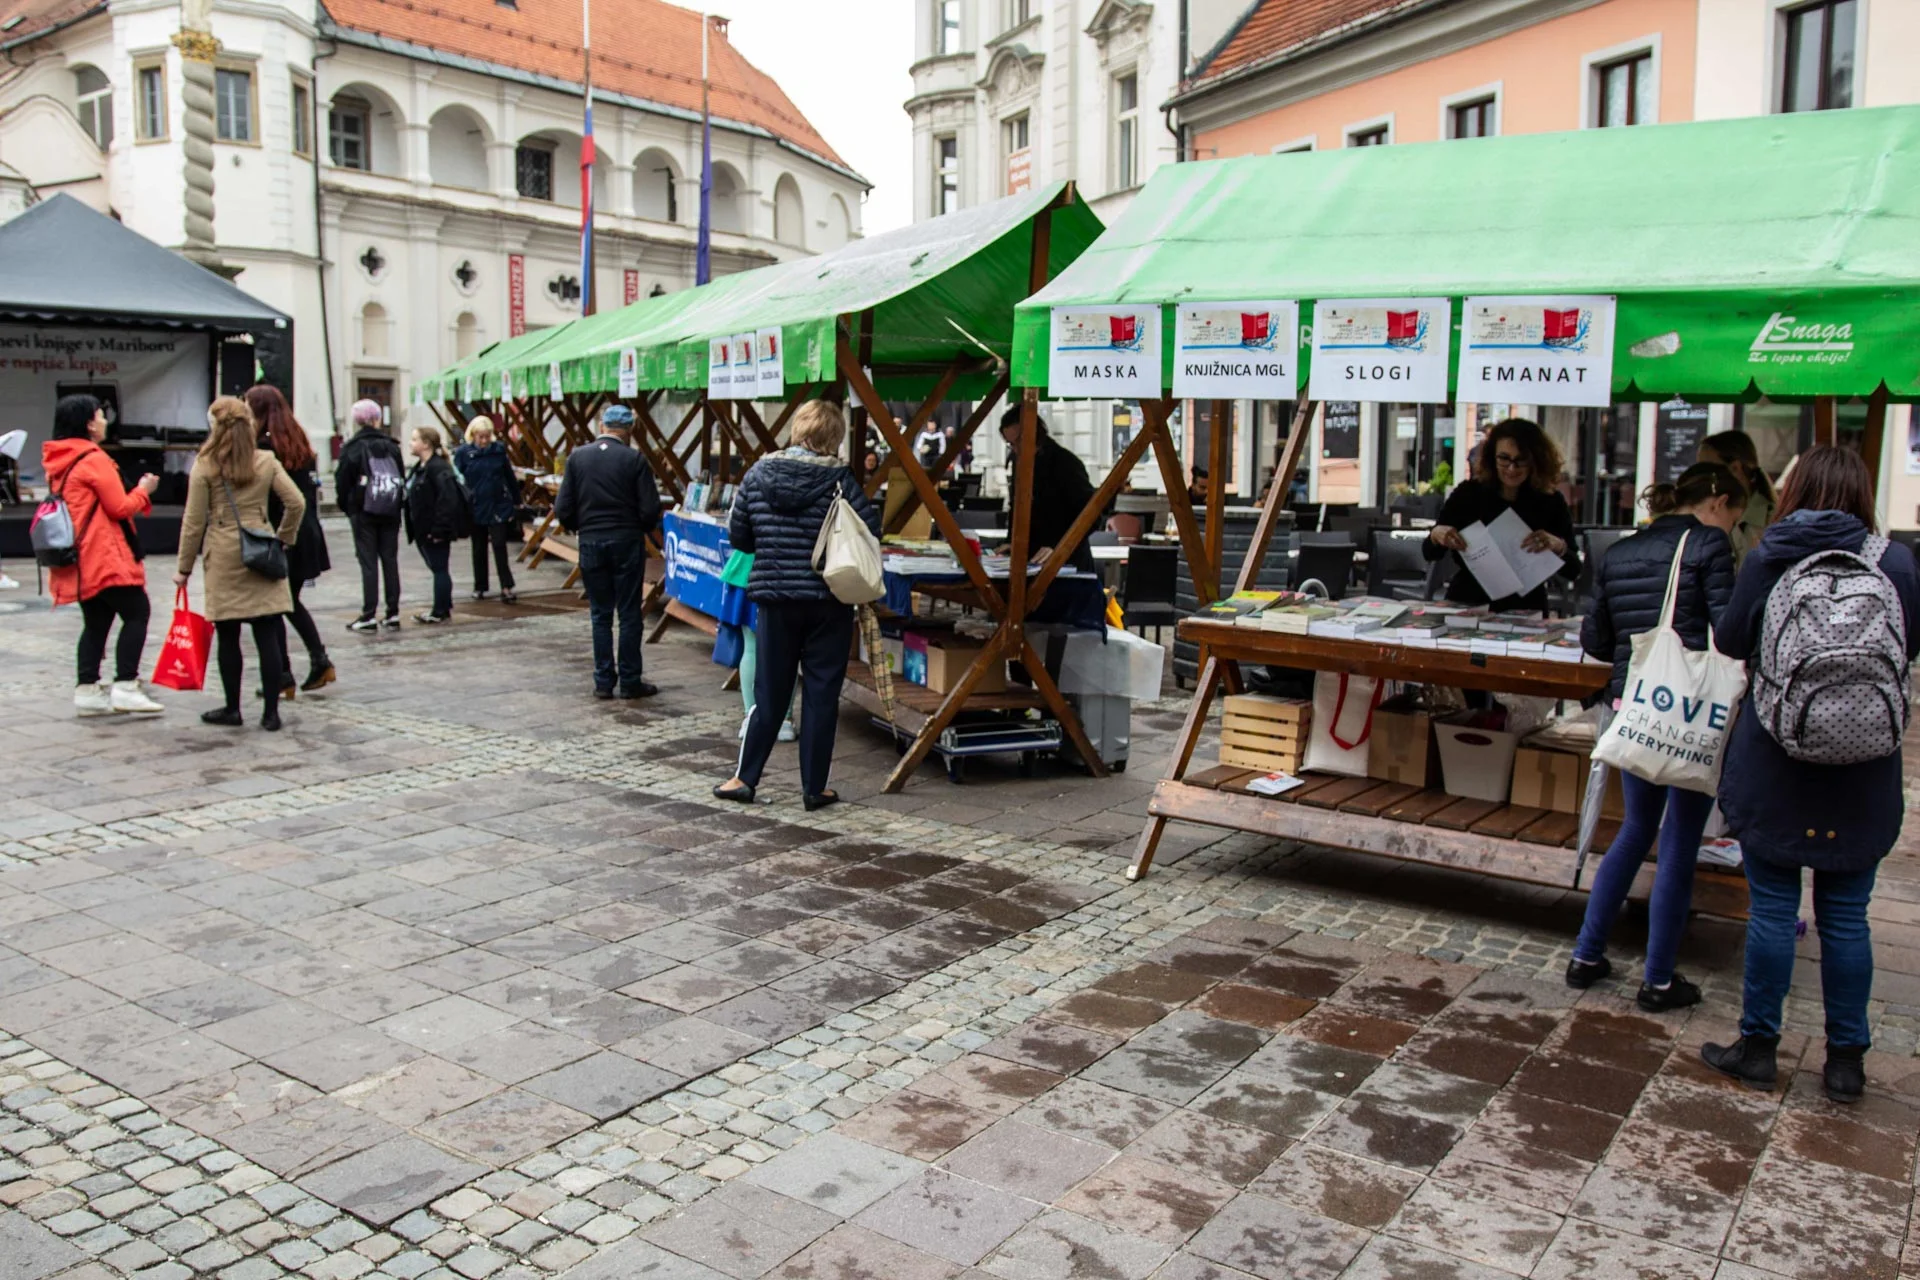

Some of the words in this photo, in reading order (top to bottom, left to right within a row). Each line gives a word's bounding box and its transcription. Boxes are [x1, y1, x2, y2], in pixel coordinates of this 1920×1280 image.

[1767, 316, 1853, 346] Snaga
[33, 332, 82, 354] knjige
[86, 339, 95, 350] v
[99, 336, 175, 352] Mariboru
[69, 354, 117, 375] knjiga
[1074, 365, 1138, 378] MASKA
[1185, 361, 1252, 377] KNJIŽNICA
[1255, 364, 1286, 377] MGL
[1345, 365, 1411, 380] SLOGI
[1482, 366, 1588, 383] EMANAT
[1633, 679, 1729, 731] LOVE
[1626, 708, 1721, 751] CHANGES
[1618, 725, 1714, 766] EVERYTHING
